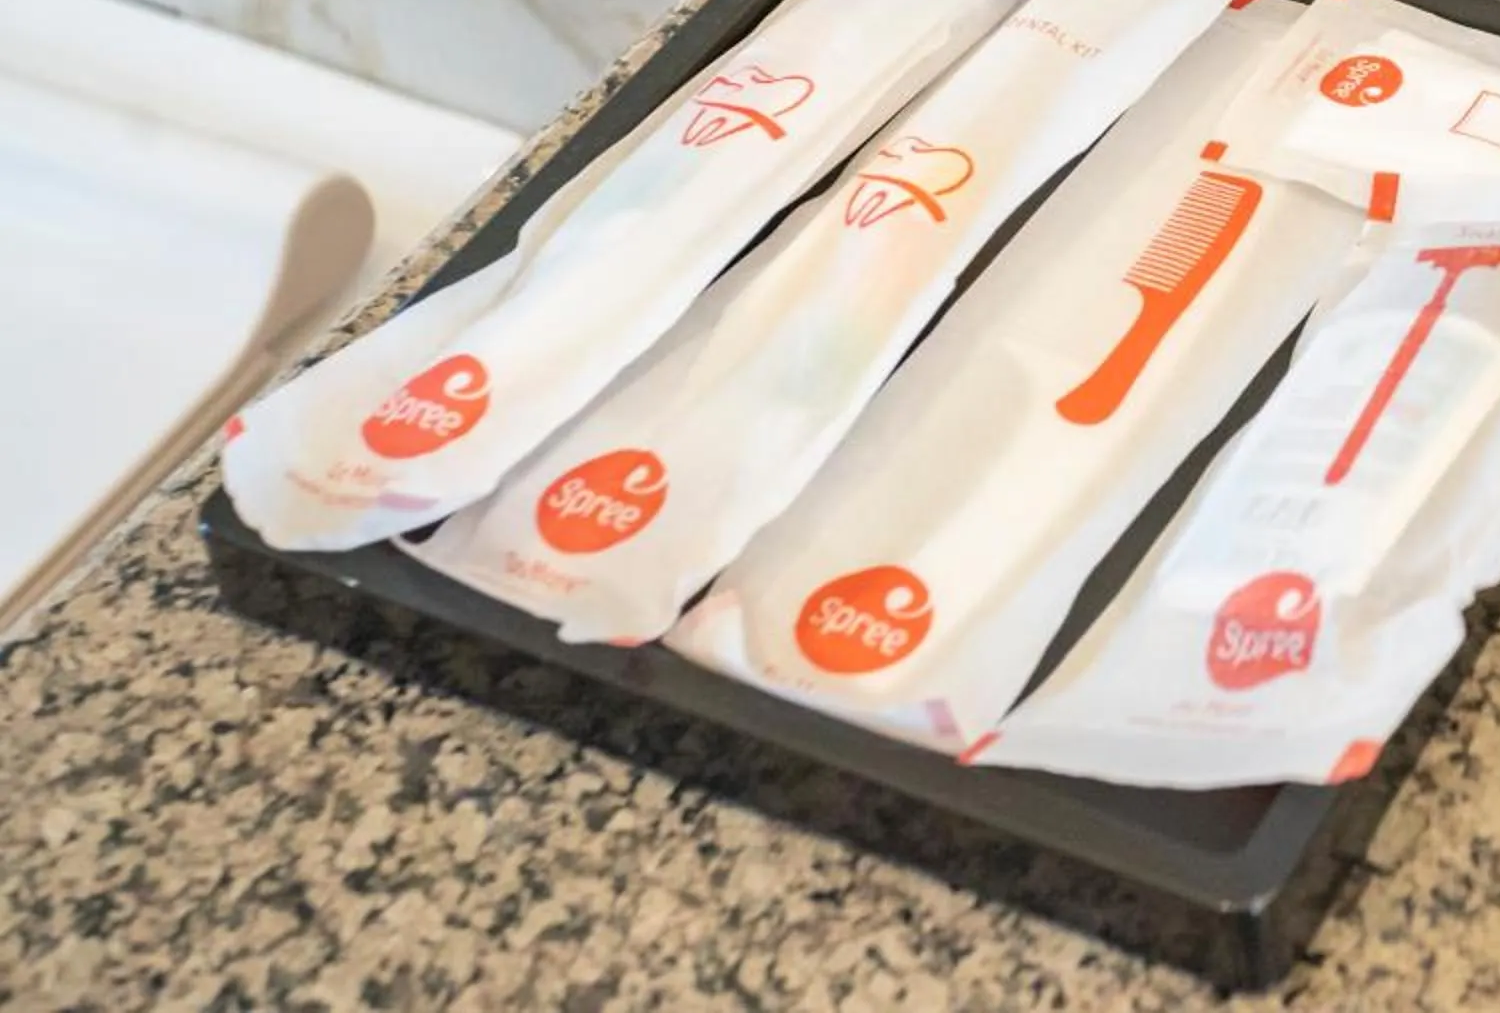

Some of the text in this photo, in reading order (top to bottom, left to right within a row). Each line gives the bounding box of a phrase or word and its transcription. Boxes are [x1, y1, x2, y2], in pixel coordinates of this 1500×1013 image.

[1072, 40, 1104, 59] KIT
[1331, 59, 1381, 100] Spree
[376, 388, 464, 437] Spree
[548, 477, 642, 533] Spree
[808, 596, 910, 658] Spree
